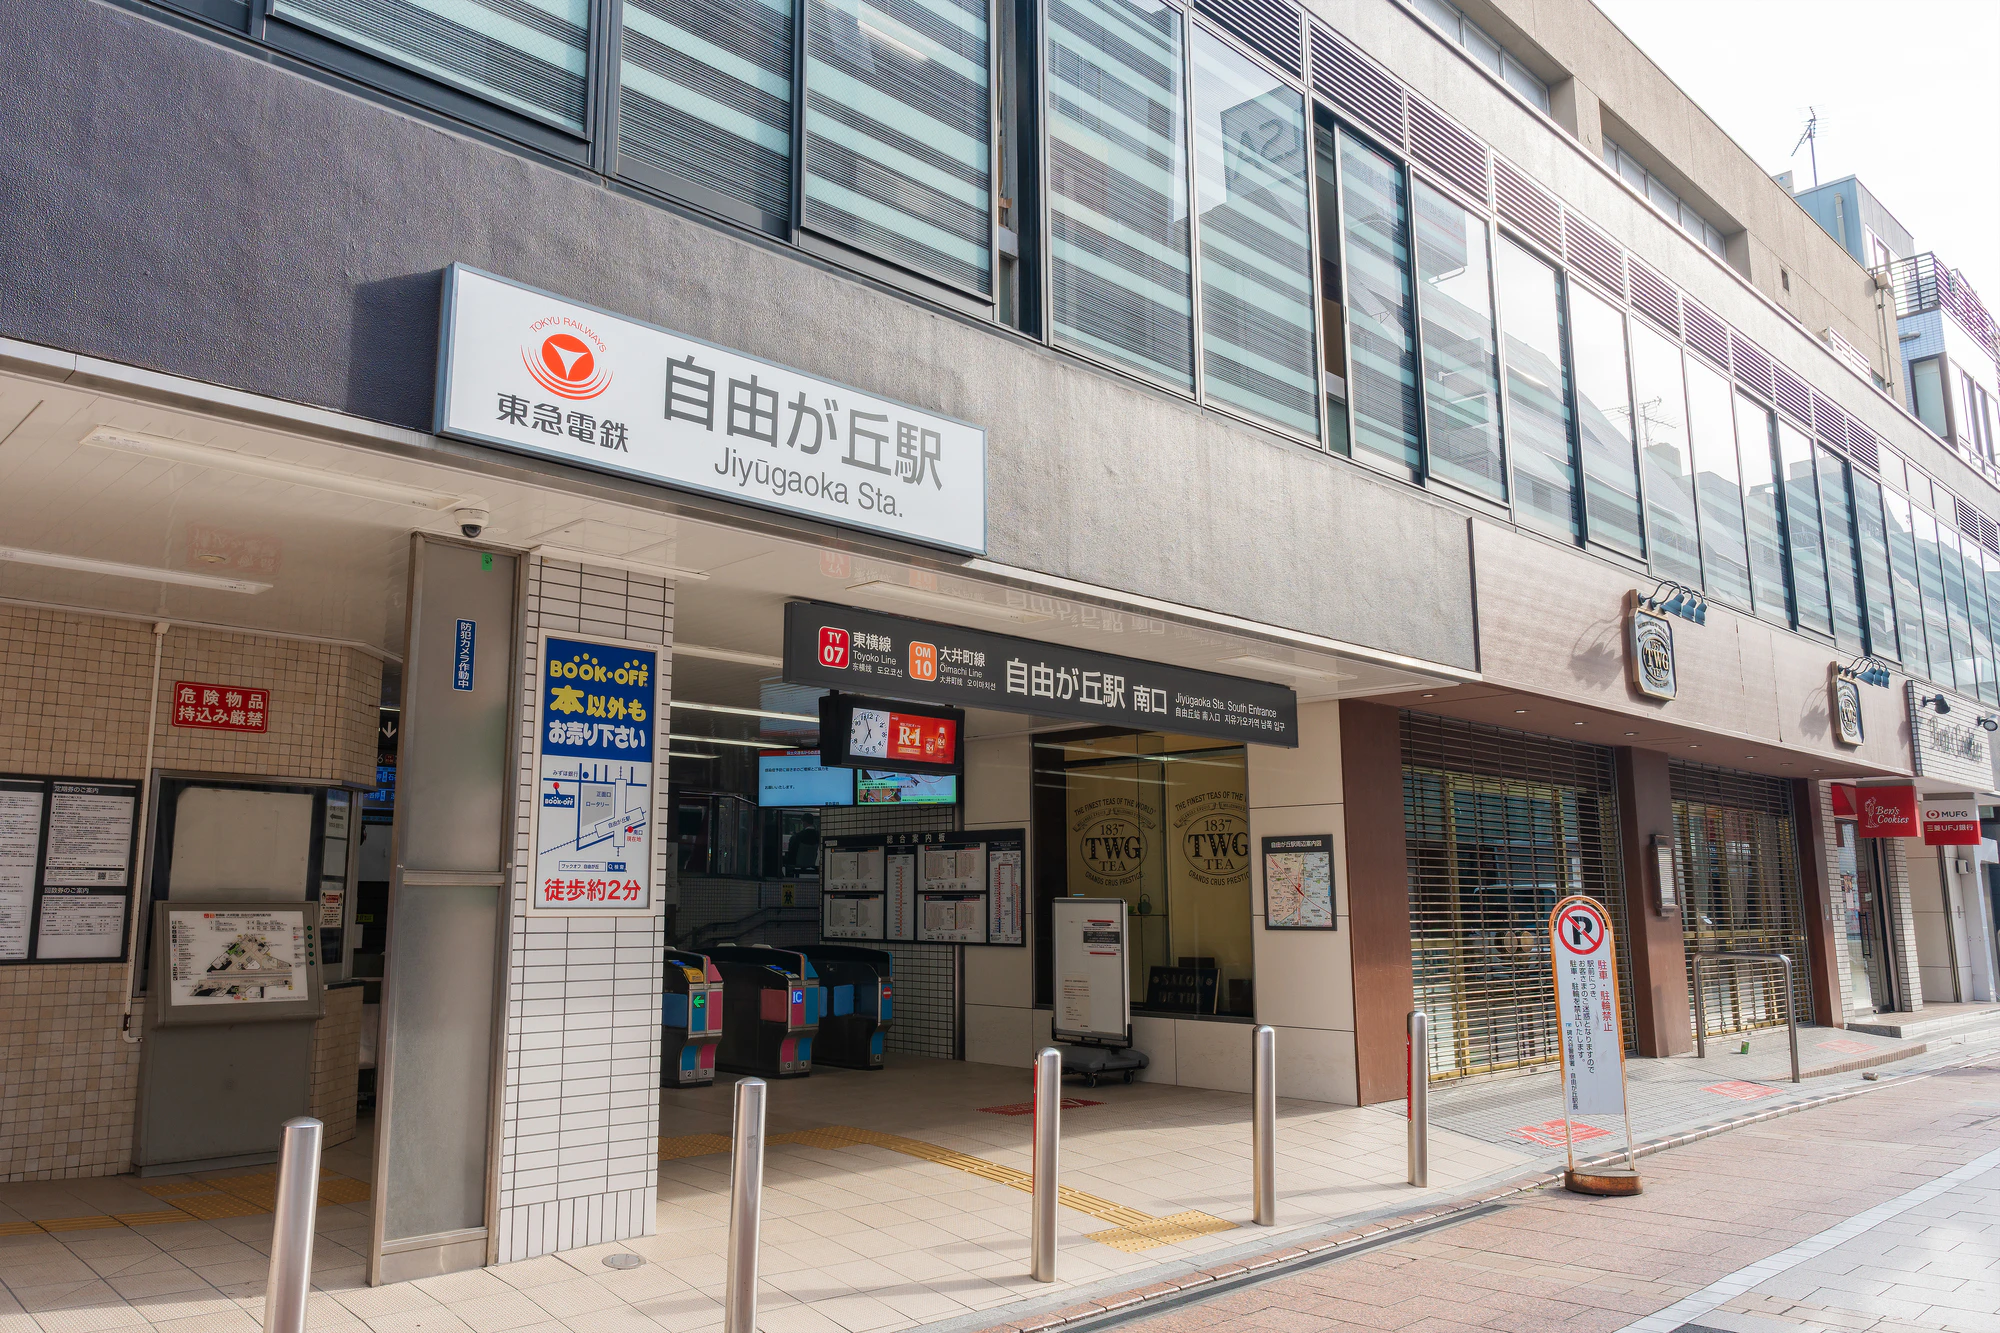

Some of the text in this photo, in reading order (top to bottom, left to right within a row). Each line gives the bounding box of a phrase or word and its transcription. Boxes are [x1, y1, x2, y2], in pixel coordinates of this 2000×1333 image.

[529, 317, 606, 352] TOKYU RAILWAYS
[496, 392, 630, 453] 東急電鉄
[664, 355, 943, 491] 自由が丘駅
[714, 446, 904, 518] Jiyūgaoka Sta.
[828, 631, 842, 644] TY
[852, 631, 892, 653] 東横線
[458, 622, 472, 688] 防犯カメラ作動中
[824, 645, 844, 664] 07
[881, 655, 896, 666] Line
[915, 646, 931, 659] OM
[939, 646, 986, 668] 大井町線
[1644, 648, 1669, 671] TWG
[877, 666, 903, 678] 도요코선
[914, 659, 932, 677] 10
[940, 662, 983, 678] Ōimachi Line
[967, 680, 996, 691] 오이마치선
[1006, 657, 1168, 716] 自由が丘駅 南口
[179, 687, 264, 710] 危険物品
[550, 684, 646, 722] 本以外も
[1175, 692, 1277, 718] Jiyūgaoka Sta. South Entrance
[178, 706, 263, 727] 持込み厳禁
[1202, 711, 1220, 722] 南入口
[1224, 714, 1285, 732] 지유가오카역 남쪽 입구
[549, 720, 646, 749] お売り下さい
[898, 726, 921, 747] R-1
[552, 769, 579, 778] みずほ銀行
[54, 785, 99, 794] 定期券のご案内
[596, 790, 612, 798] 正面口
[1084, 800, 1102, 812] FINEST
[1103, 798, 1116, 806] TEAS
[1124, 799, 1135, 808] THE
[1136, 802, 1154, 815] WORLD
[1175, 791, 1243, 811] THE FINEST TEAS OF THE
[1876, 806, 1900, 815] Ben's
[1878, 815, 1909, 824] Cookies
[608, 815, 631, 829] 自由が丘駅
[1100, 824, 1124, 836] 1837
[1205, 819, 1232, 832] 1837
[1927, 824, 1974, 832] 三菱UFJ銀行
[886, 833, 946, 844] 総合案内板
[1188, 832, 1248, 858] TWG
[1085, 836, 1142, 860] TWG
[1099, 860, 1126, 871] TEA
[1204, 859, 1235, 870] TEA
[1085, 871, 1143, 887] GRANDS CRUS PRESTIGE
[1188, 870, 1209, 885] GRANDS
[1210, 878, 1225, 886] CRUS
[544, 879, 642, 902] 徒歩約2分
[1587, 960, 1597, 1000] 駅前につき、
[793, 991, 803, 1004] IC
[1598, 960, 1613, 1032] 駐車・駐輪禁止
[1570, 960, 1585, 1062] 駐車・駐輪を禁止いたします。
[1579, 960, 1594, 1074] お客さまのご迷惑となりますので
